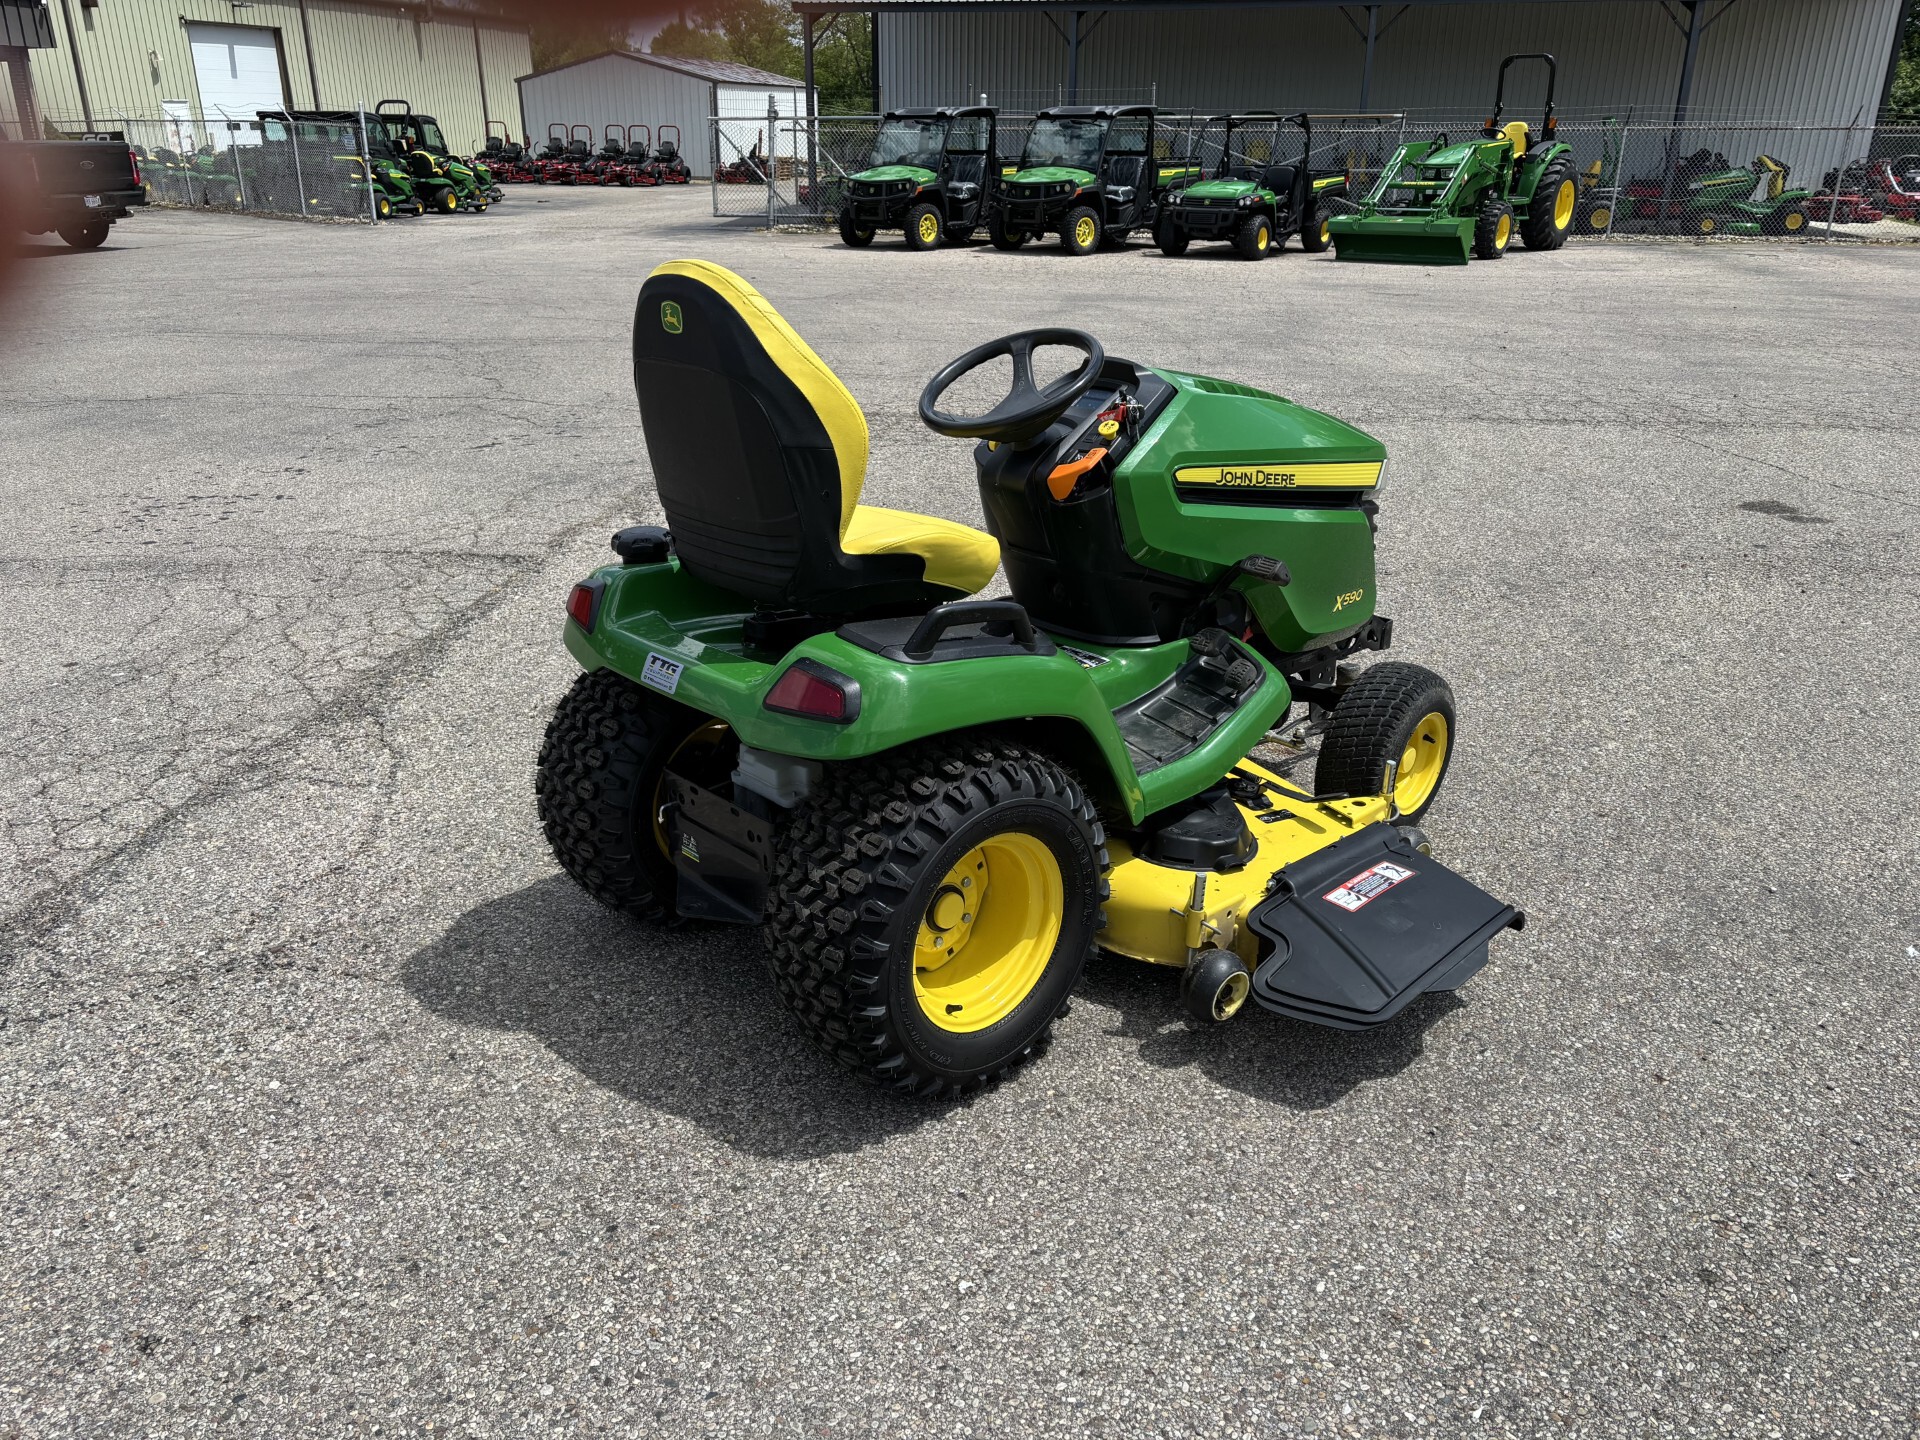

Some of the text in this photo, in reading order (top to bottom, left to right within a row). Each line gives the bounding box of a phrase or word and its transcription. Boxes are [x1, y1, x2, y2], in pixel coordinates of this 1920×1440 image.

[1216, 468, 1296, 486] JOHN DEERE
[1333, 589, 1363, 612] X590
[650, 655, 680, 677] TTG
